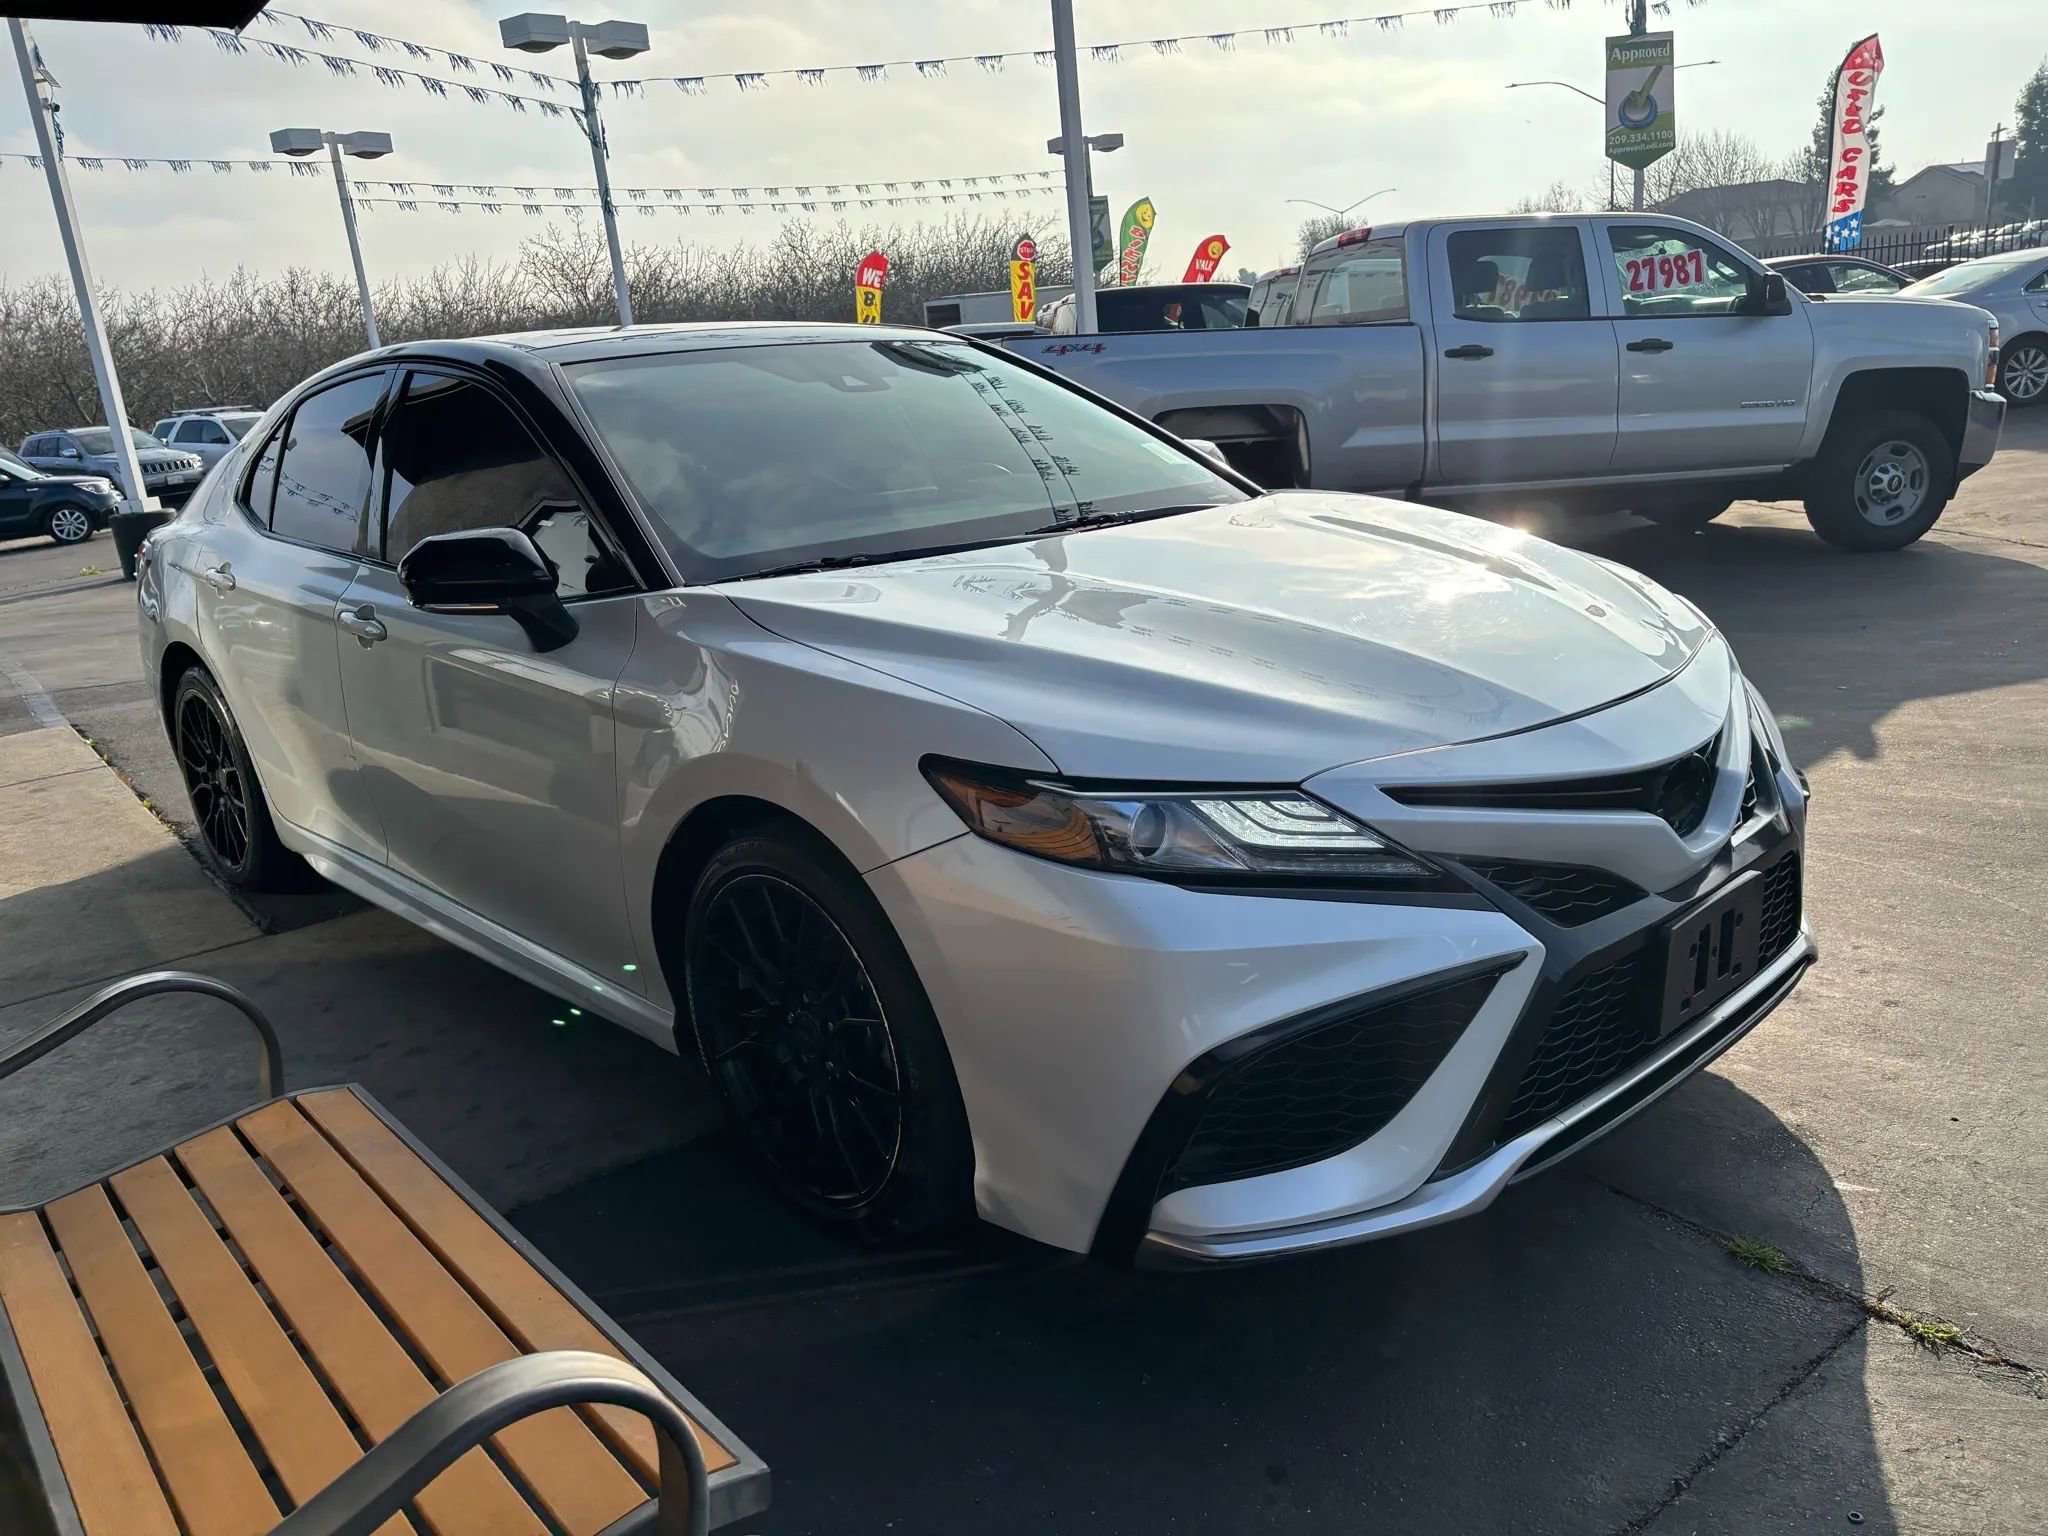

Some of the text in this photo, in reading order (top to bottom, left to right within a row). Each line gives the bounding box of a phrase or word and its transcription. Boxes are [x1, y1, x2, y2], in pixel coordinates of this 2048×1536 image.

[1611, 42, 1670, 63] Approved
[1608, 130, 1674, 145] 209.334.1100
[1832, 70, 1873, 213] USED CARS
[1196, 258, 1214, 272] WALK
[1626, 250, 1703, 292] 27987
[862, 267, 884, 288] WE
